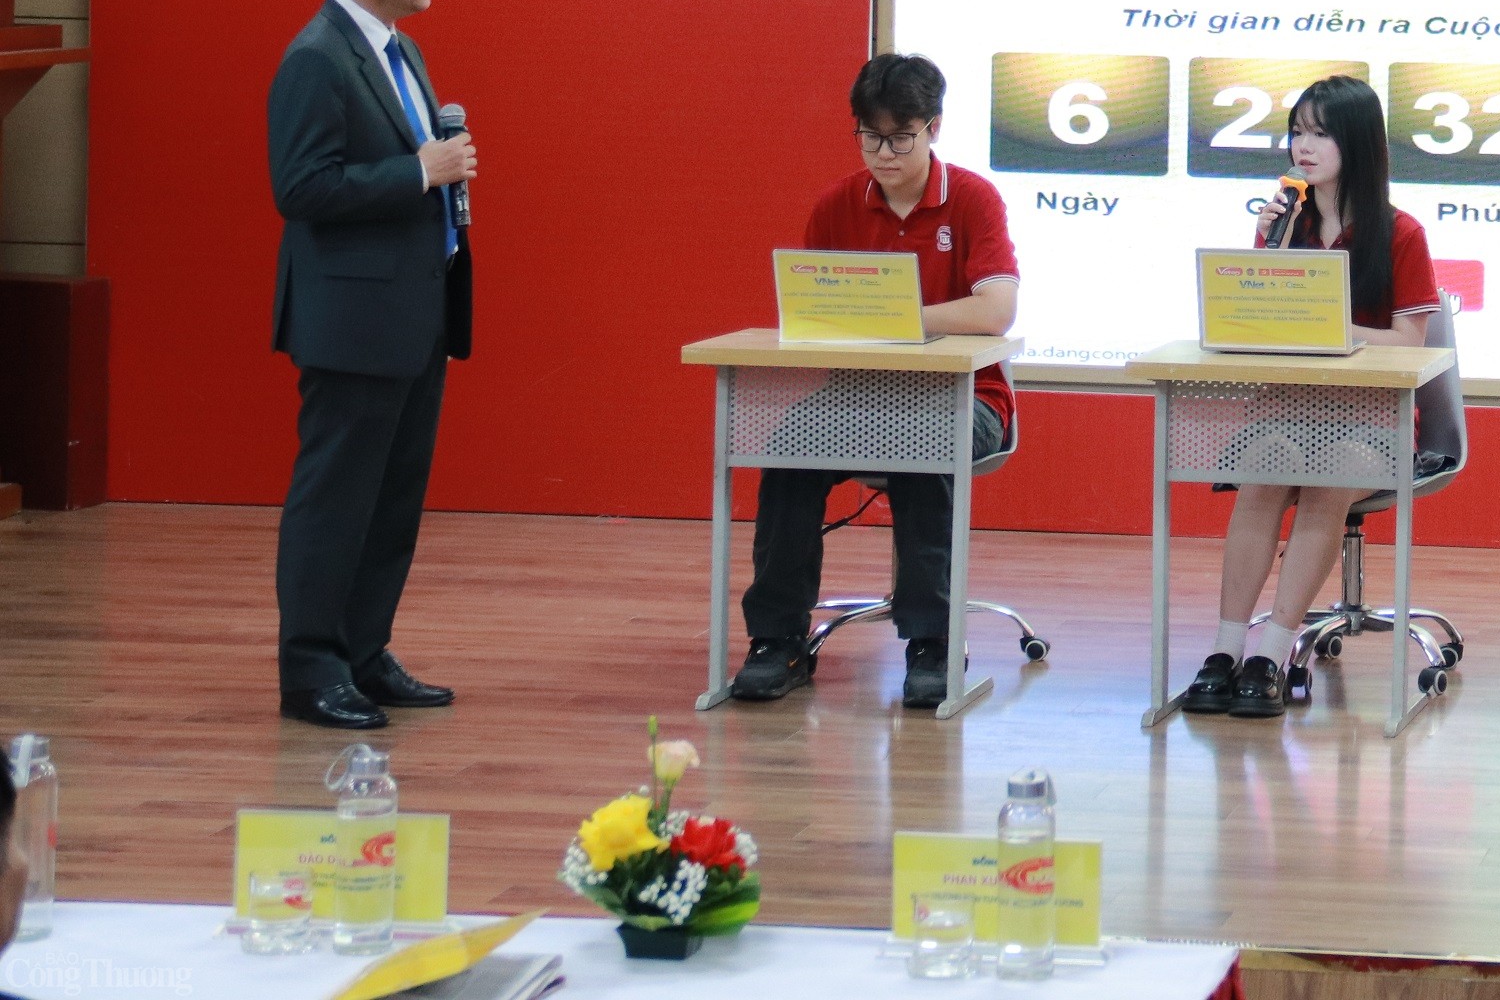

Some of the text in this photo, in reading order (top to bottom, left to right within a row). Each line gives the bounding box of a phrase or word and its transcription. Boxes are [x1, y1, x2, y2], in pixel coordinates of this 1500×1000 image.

[1123, 8, 1198, 29] Thời
[1207, 11, 1281, 34] gian
[1293, 8, 1366, 33] diễn
[1378, 19, 1411, 34] ra
[1047, 81, 1111, 147] 6
[1036, 191, 1120, 216] Ngày
